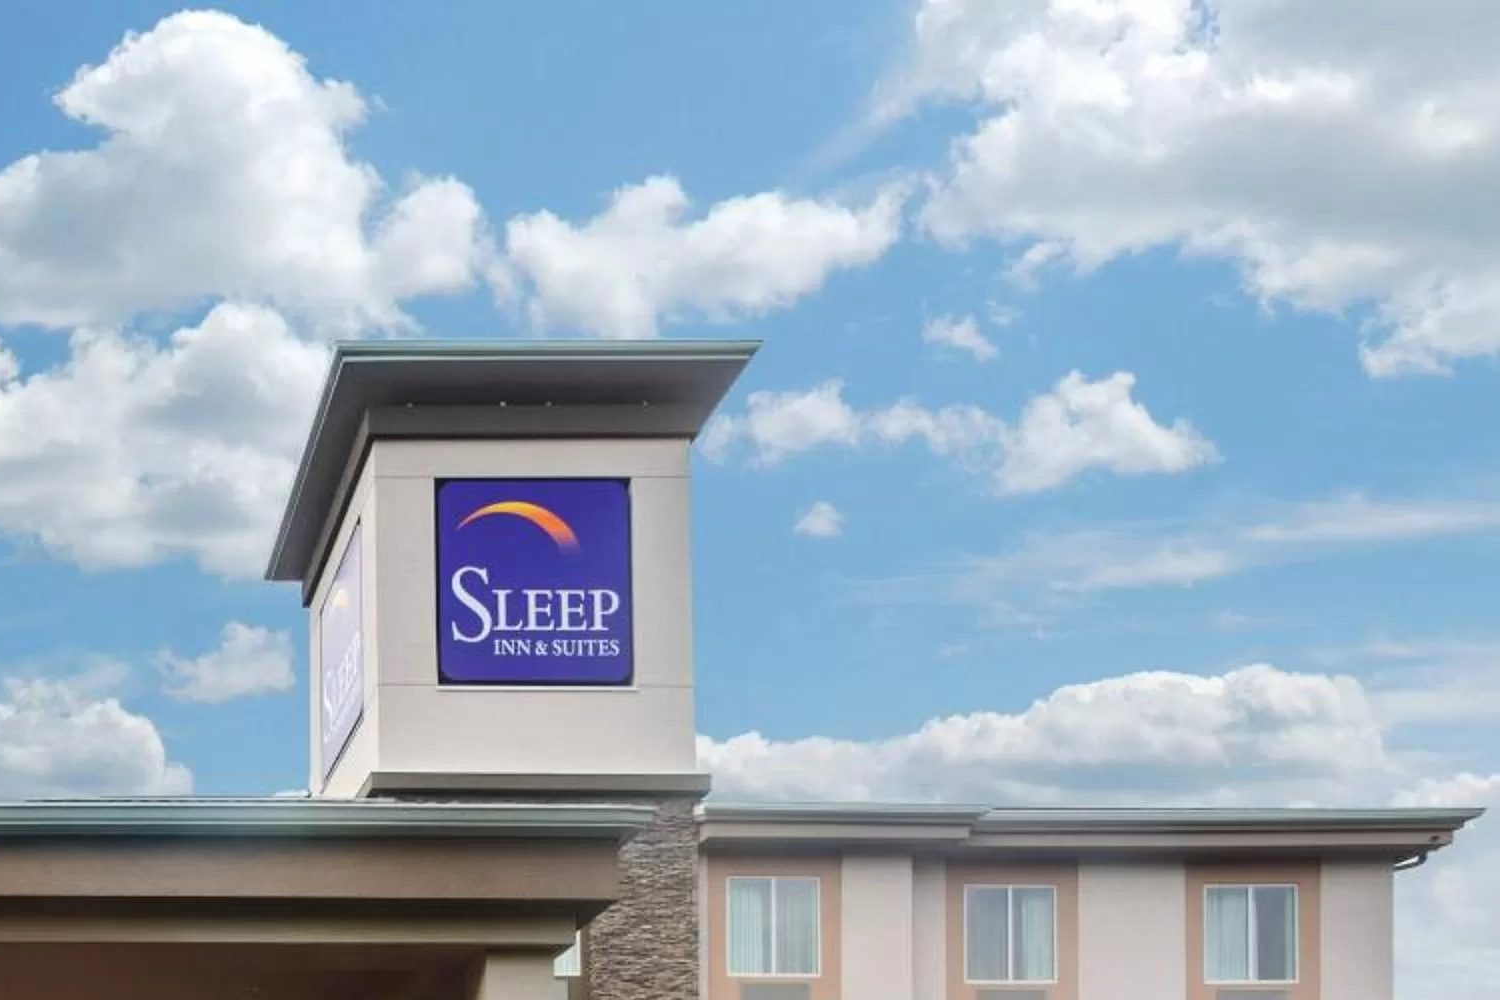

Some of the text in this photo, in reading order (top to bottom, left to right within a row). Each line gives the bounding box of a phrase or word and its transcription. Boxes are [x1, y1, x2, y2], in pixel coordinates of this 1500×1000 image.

[451, 566, 620, 643] SLEEP
[494, 639, 620, 657] INN & SUITES
